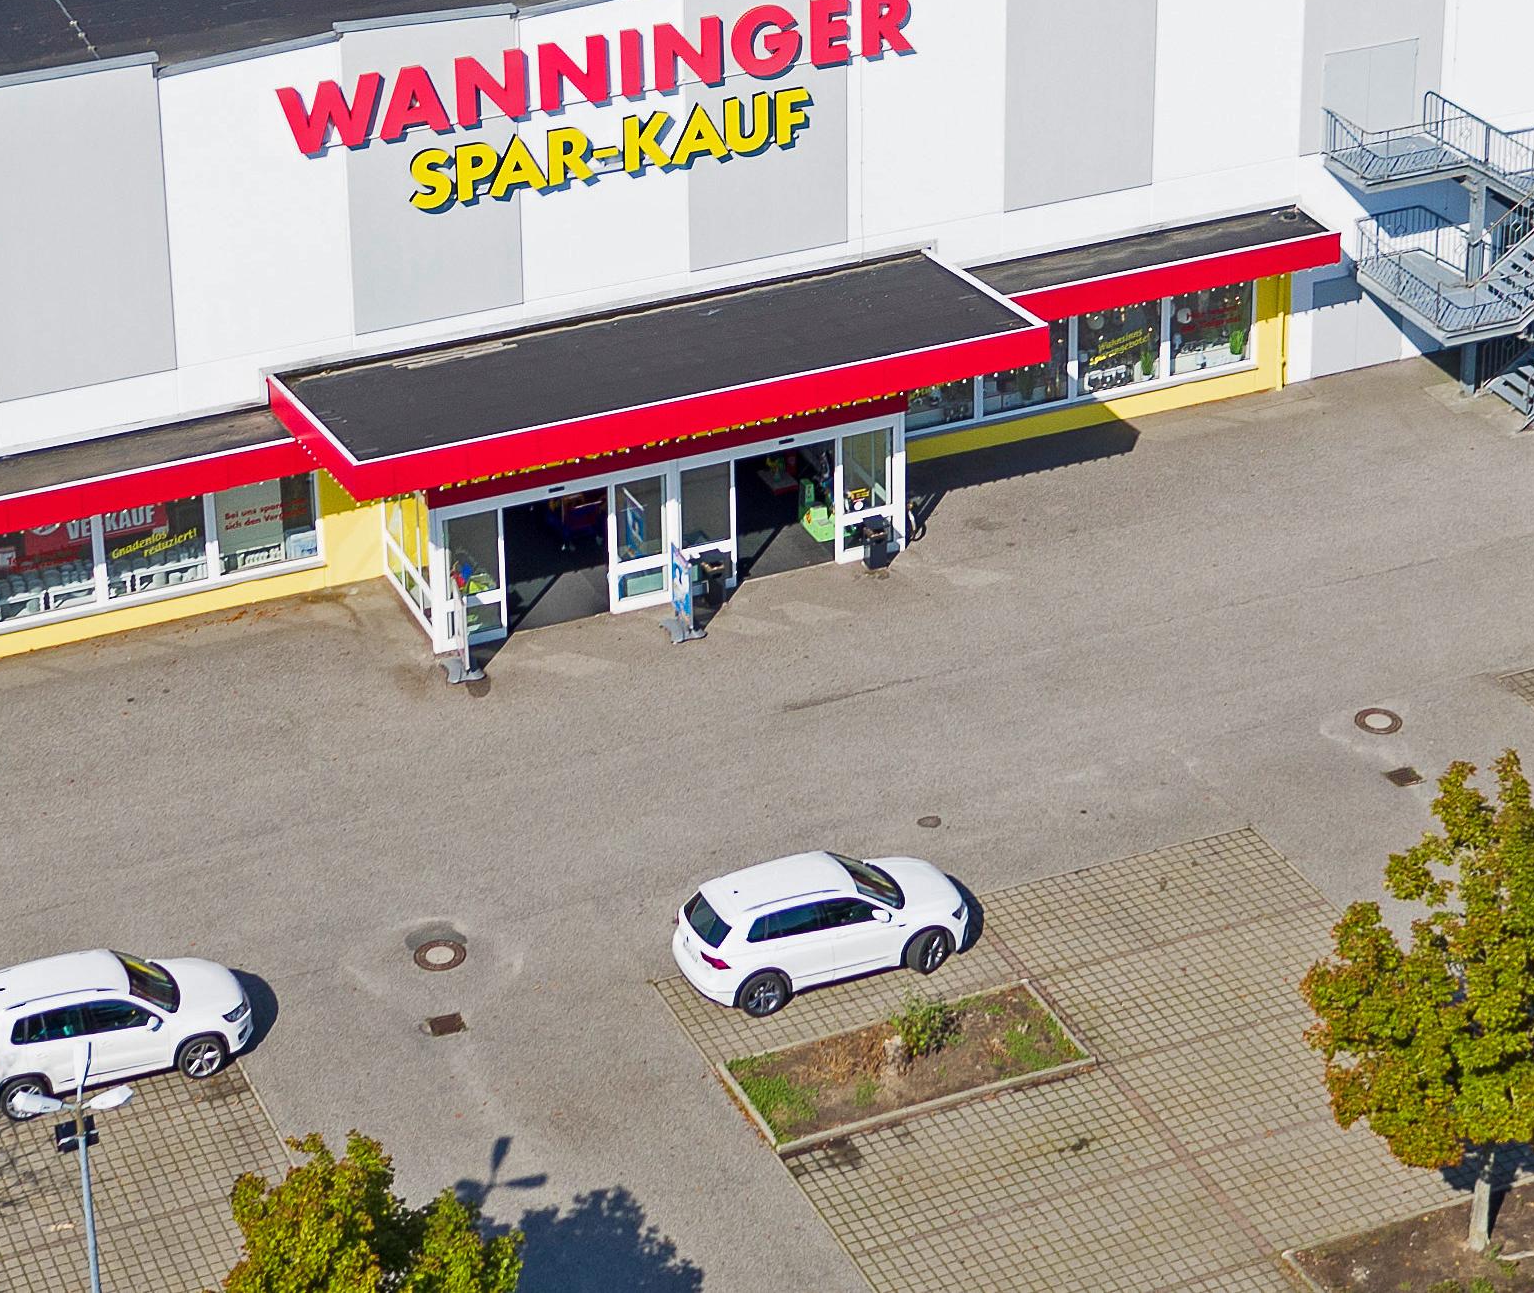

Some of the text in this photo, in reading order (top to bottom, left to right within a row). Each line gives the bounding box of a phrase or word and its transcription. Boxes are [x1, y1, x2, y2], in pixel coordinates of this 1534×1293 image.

[409, 87, 811, 213] SPAR-KAUF
[67, 505, 155, 540] VEKAUF
[112, 531, 167, 559] Gnadenlos
[143, 527, 197, 557] reduziert!
